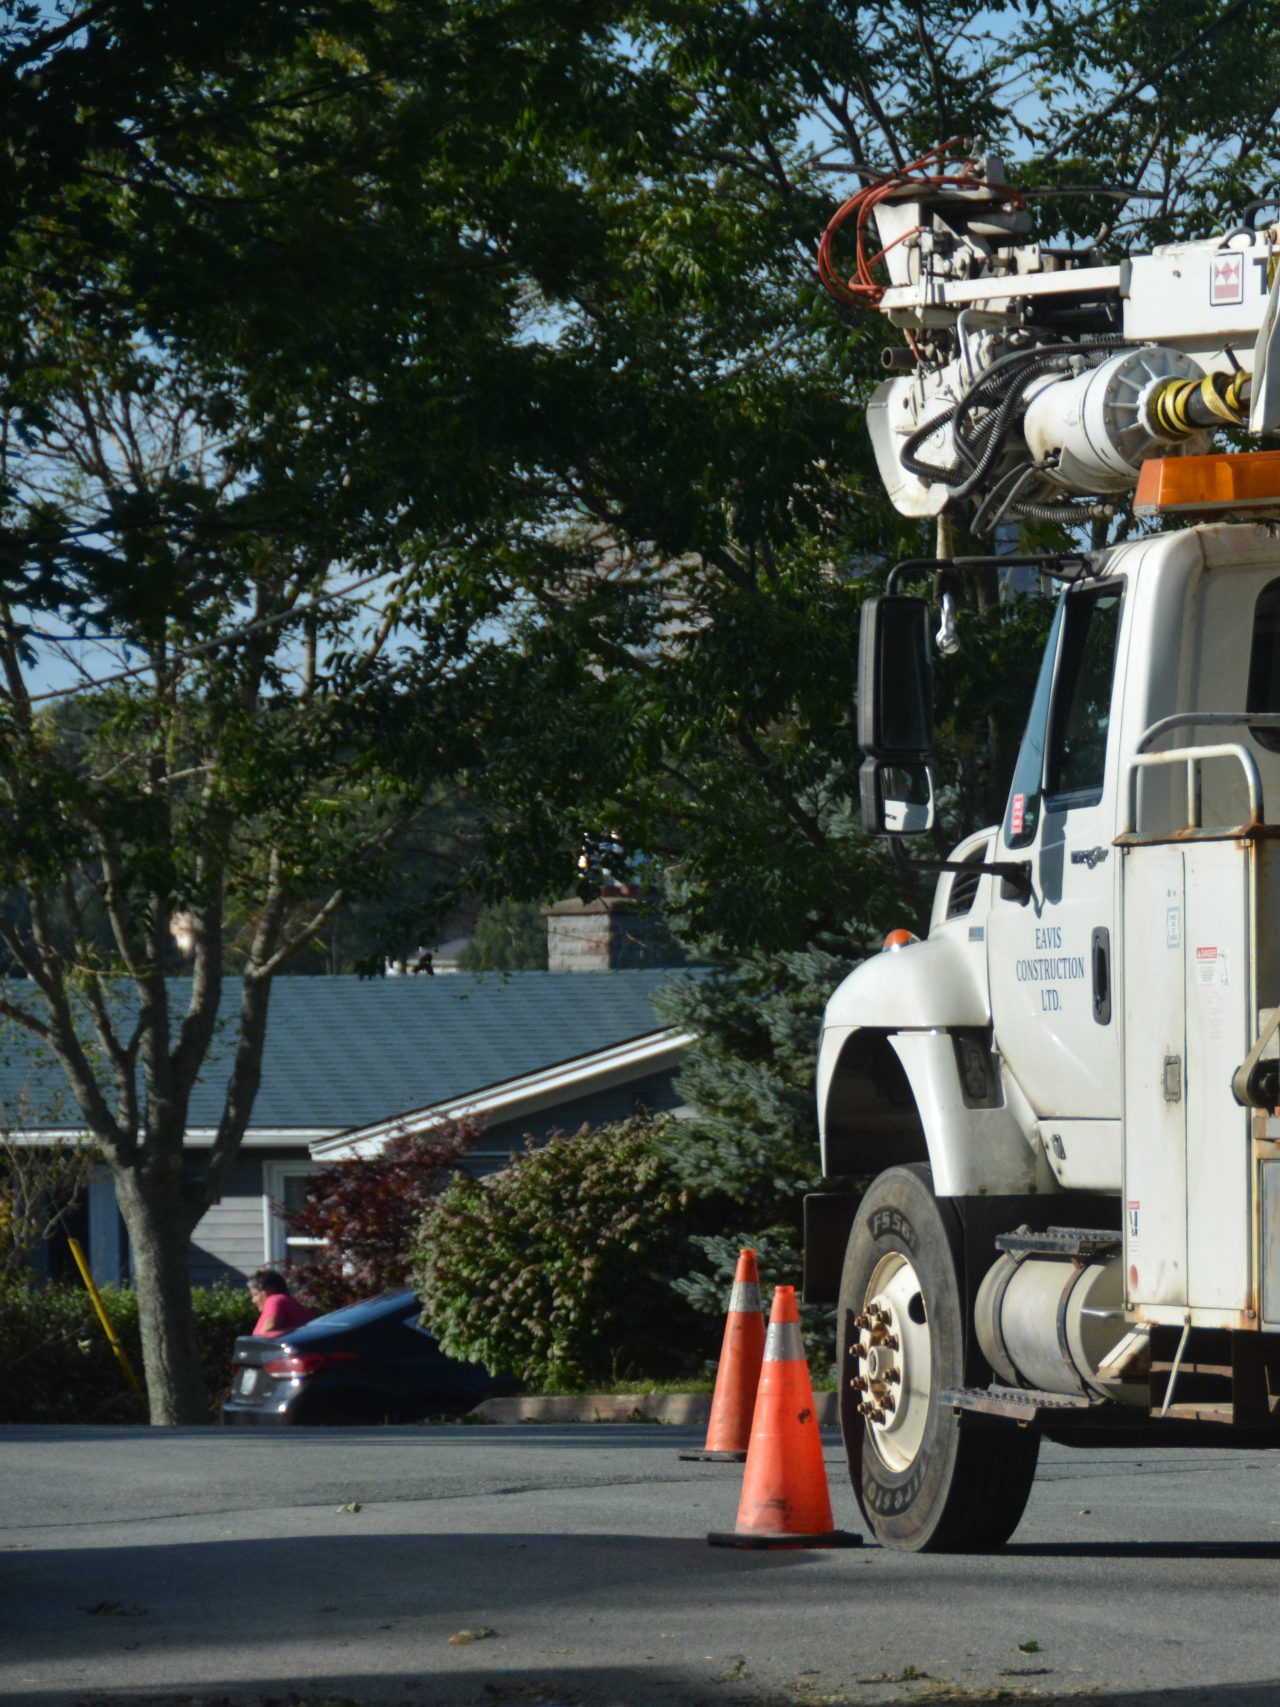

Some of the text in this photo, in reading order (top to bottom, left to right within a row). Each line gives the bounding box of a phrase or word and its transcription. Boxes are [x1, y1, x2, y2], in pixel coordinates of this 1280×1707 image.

[1035, 926, 1062, 949] EAVIS
[1015, 956, 1085, 981] CONSTRUCTION
[1040, 989, 1062, 1011] LTD.
